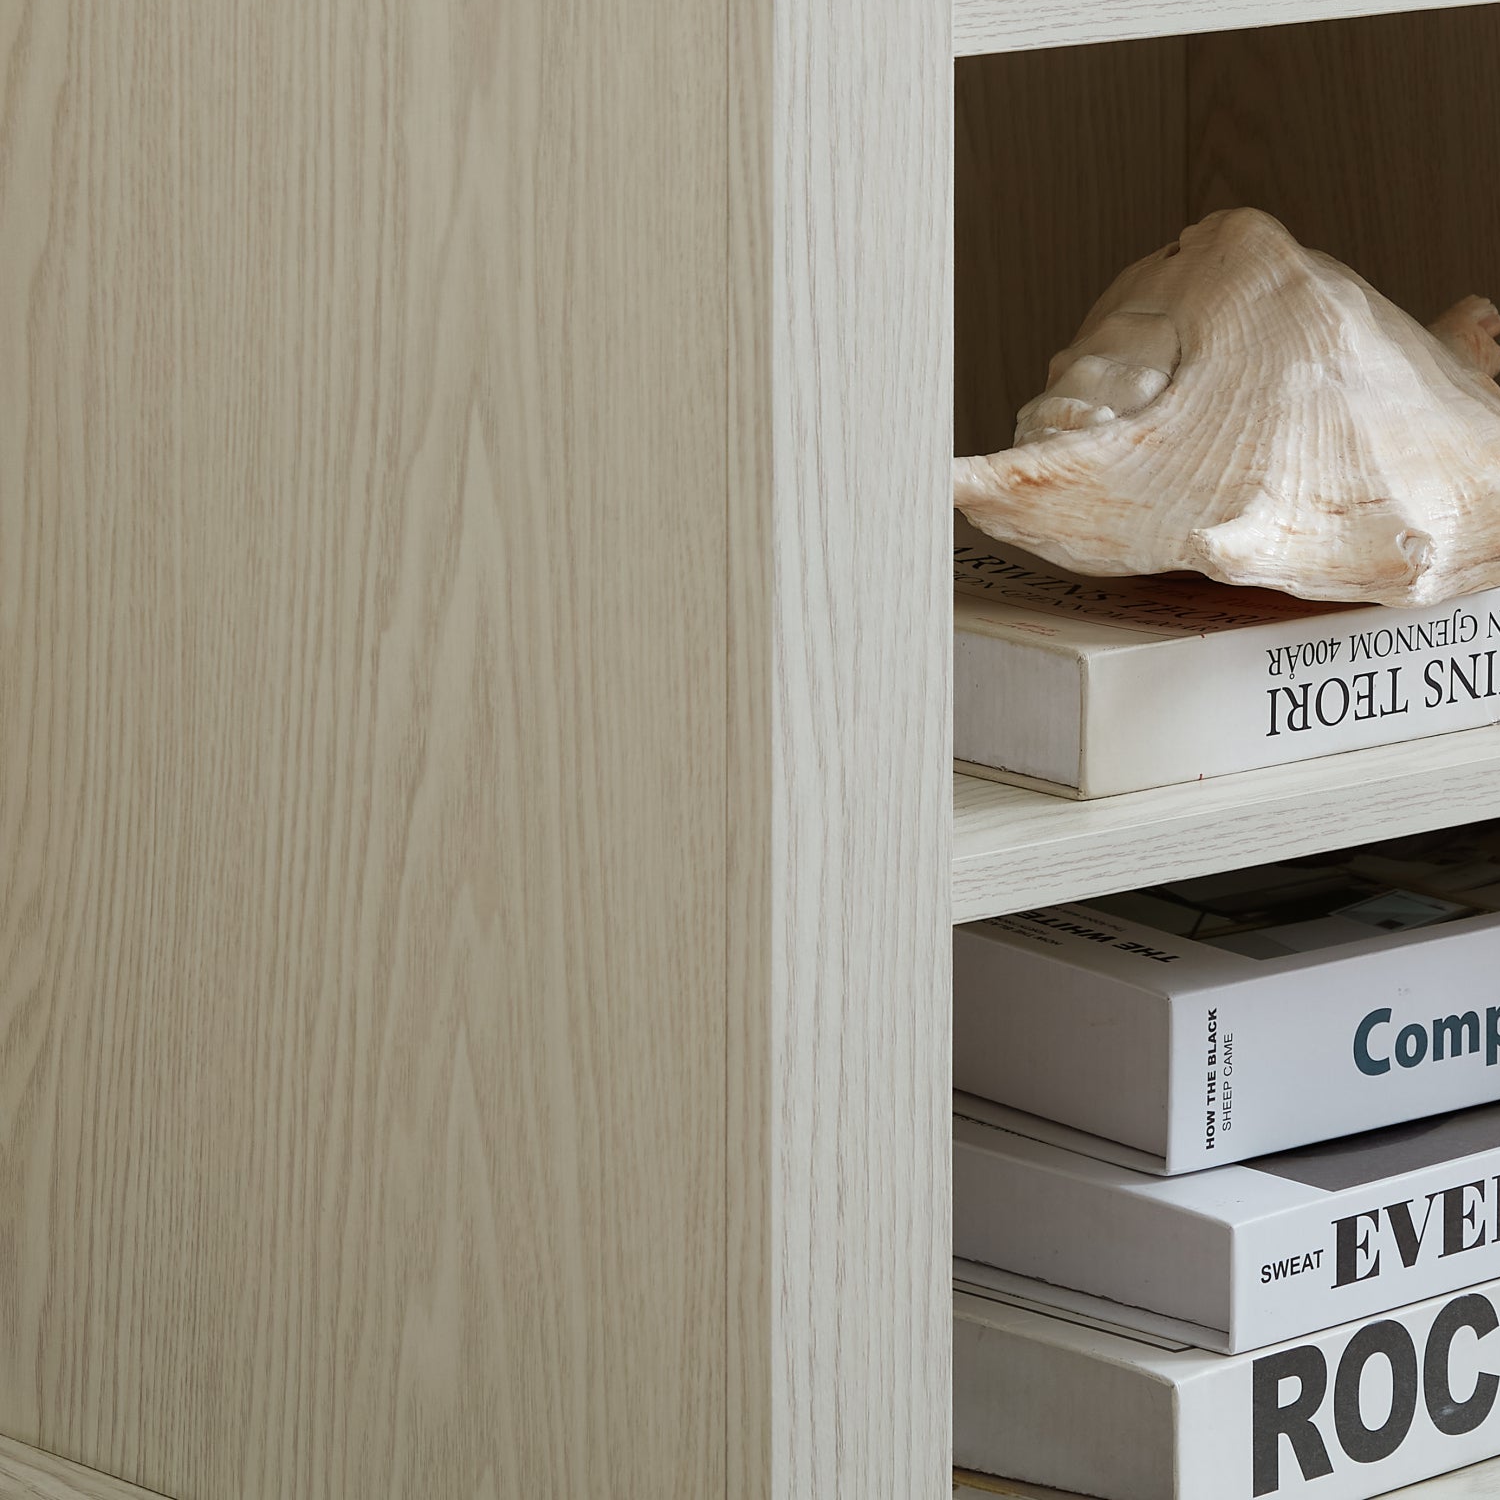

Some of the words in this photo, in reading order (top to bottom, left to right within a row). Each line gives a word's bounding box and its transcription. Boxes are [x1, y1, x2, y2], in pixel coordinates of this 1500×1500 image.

[1348, 608, 1478, 663] GJENNOM
[1265, 637, 1342, 680] 400ÅR
[1265, 666, 1409, 737] TEORI
[1015, 910, 1117, 944] WHITE
[1112, 941, 1182, 963] THE
[1207, 1007, 1218, 1067] BLACK
[1223, 1032, 1234, 1077] CAME
[1206, 1070, 1217, 1107] THE
[1222, 1080, 1233, 1132] SHEEP
[1205, 1110, 1216, 1151] HOW
[1260, 1248, 1324, 1285] SWEAT
